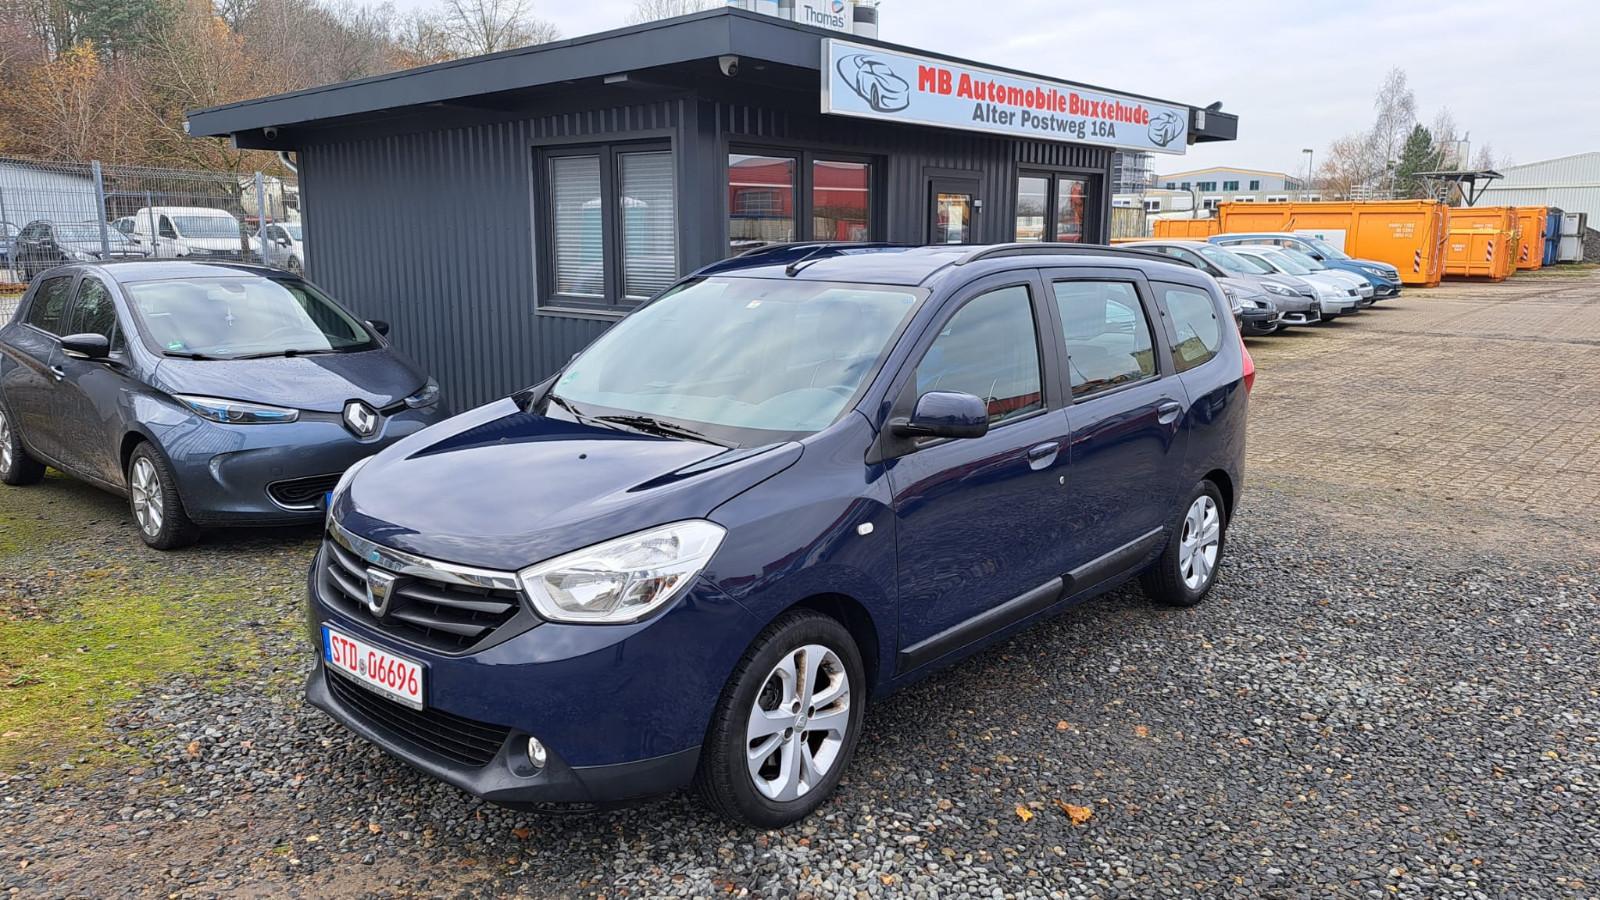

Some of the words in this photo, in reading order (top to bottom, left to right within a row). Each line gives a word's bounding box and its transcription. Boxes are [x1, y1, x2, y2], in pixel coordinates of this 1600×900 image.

[804, 5, 844, 28] Thomas
[918, 65, 952, 95] MB
[957, 73, 1066, 113] Automobile
[1069, 93, 1149, 125] Buxtehude
[972, 103, 1016, 126] Alter
[1021, 110, 1086, 139] Postweg
[1091, 121, 1116, 138] 16A
[332, 635, 357, 671] STD
[368, 651, 418, 696] 06696
